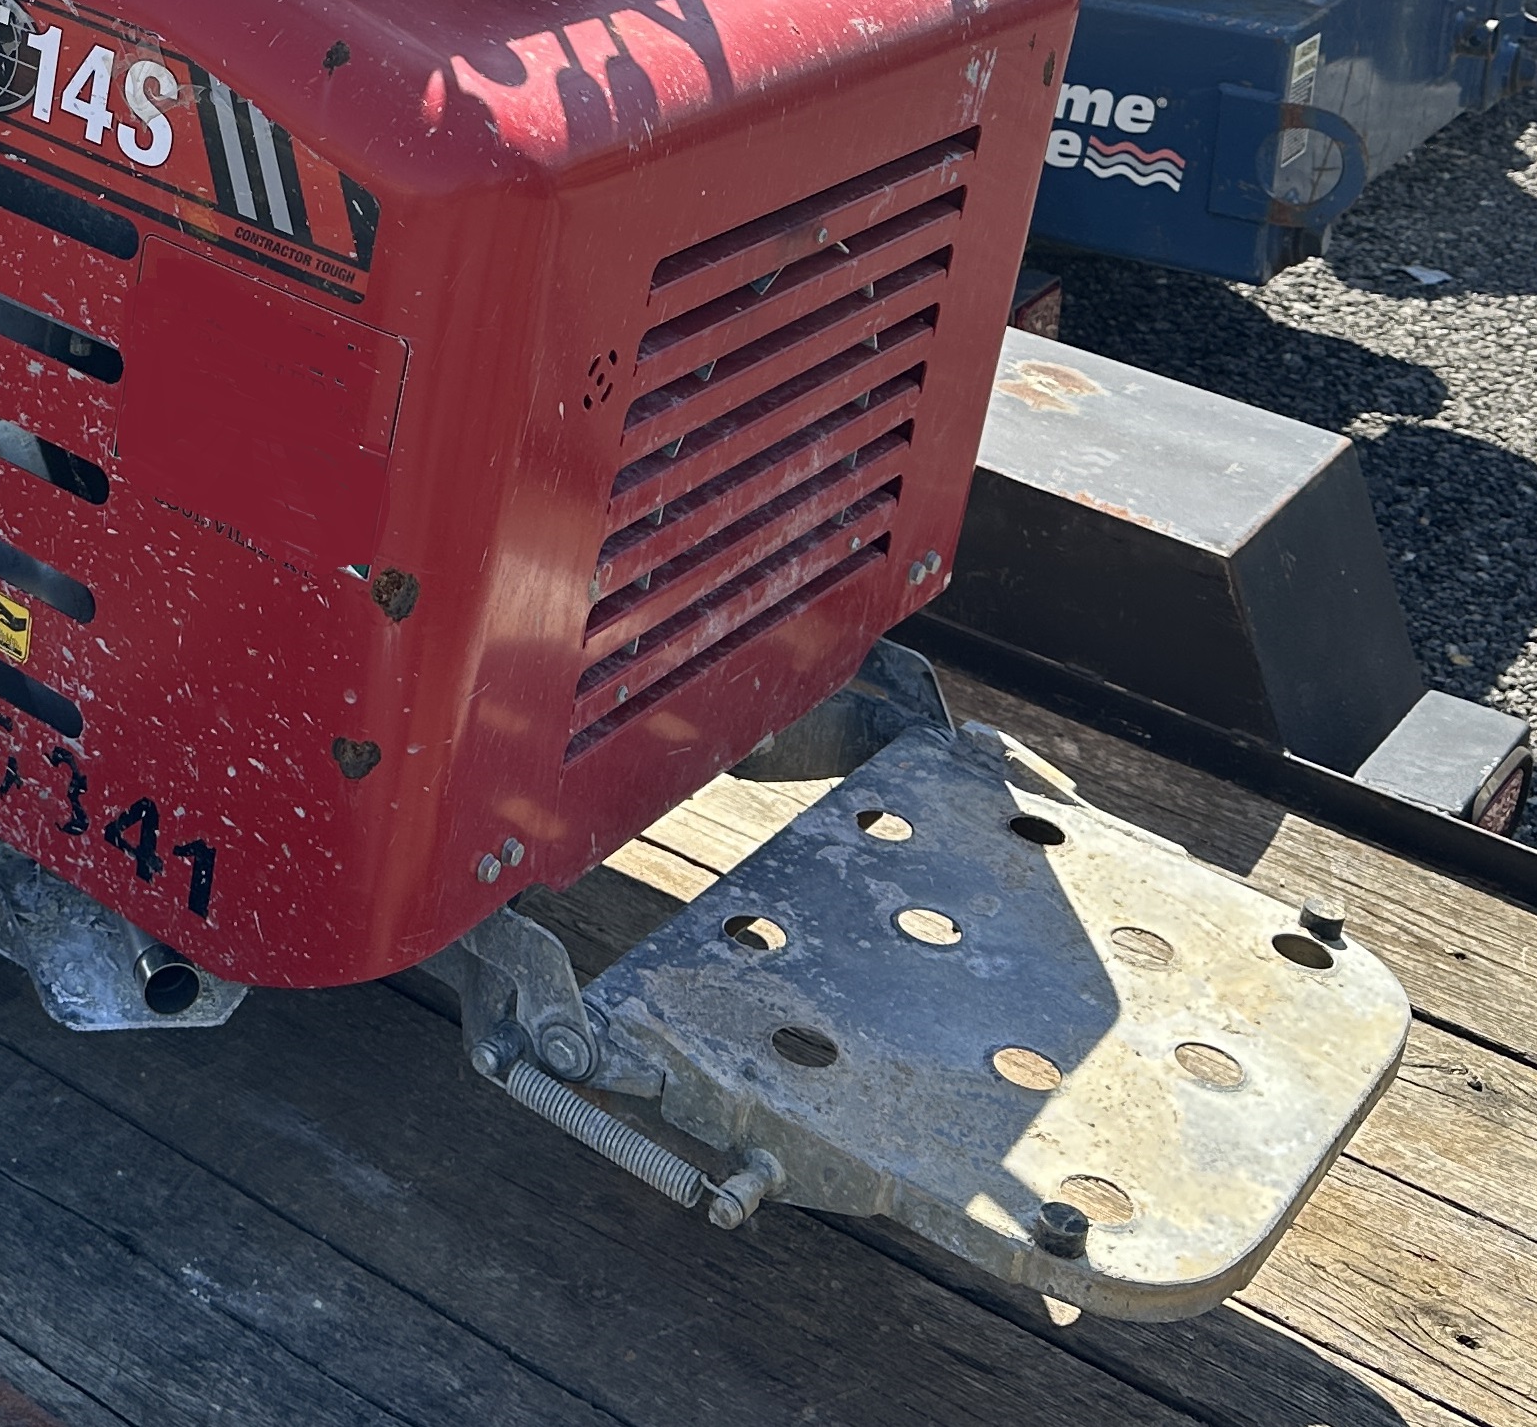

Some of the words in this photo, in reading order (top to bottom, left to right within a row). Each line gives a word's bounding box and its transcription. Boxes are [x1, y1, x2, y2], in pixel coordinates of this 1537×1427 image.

[26, 24, 181, 168] 14S
[233, 226, 313, 267] CONTRACTOR
[314, 257, 356, 285] TOUGH
